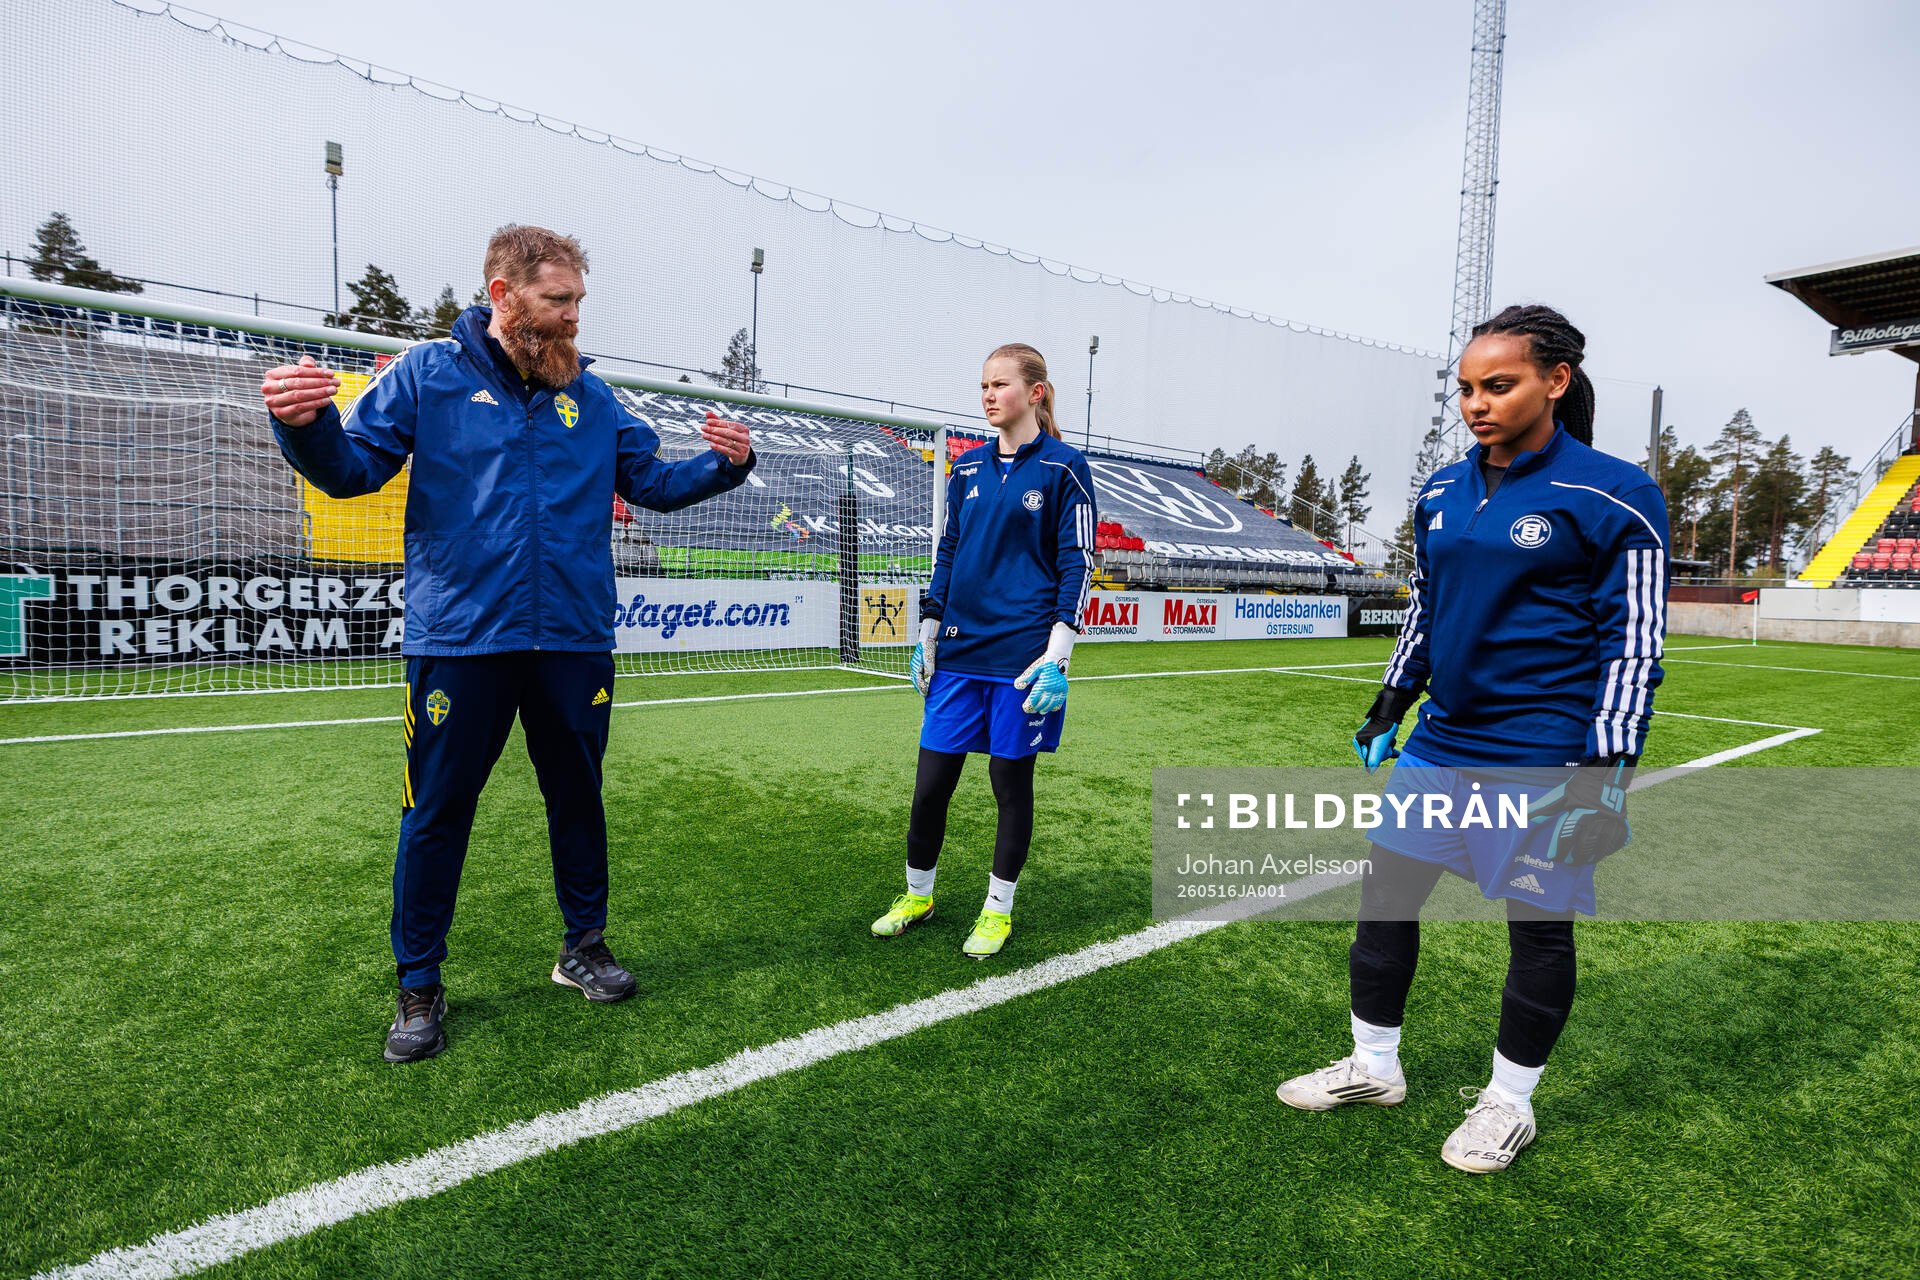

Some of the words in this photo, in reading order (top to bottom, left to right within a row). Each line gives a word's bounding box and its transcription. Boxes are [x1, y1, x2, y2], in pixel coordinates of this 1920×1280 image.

[1084, 597, 1139, 626] MAXI
[1163, 599, 1217, 625] MAXI
[1235, 598, 1341, 619] Handelsbanken
[100, 617, 349, 655] REKLAM
[945, 626, 958, 637] 19
[1087, 626, 1138, 635] STORMARKNAD
[1172, 626, 1216, 634] STORMARKNAD
[1266, 623, 1314, 635] ÖSTERSUND
[1510, 880, 1545, 894] adidas
[1464, 1150, 1511, 1164] F50
